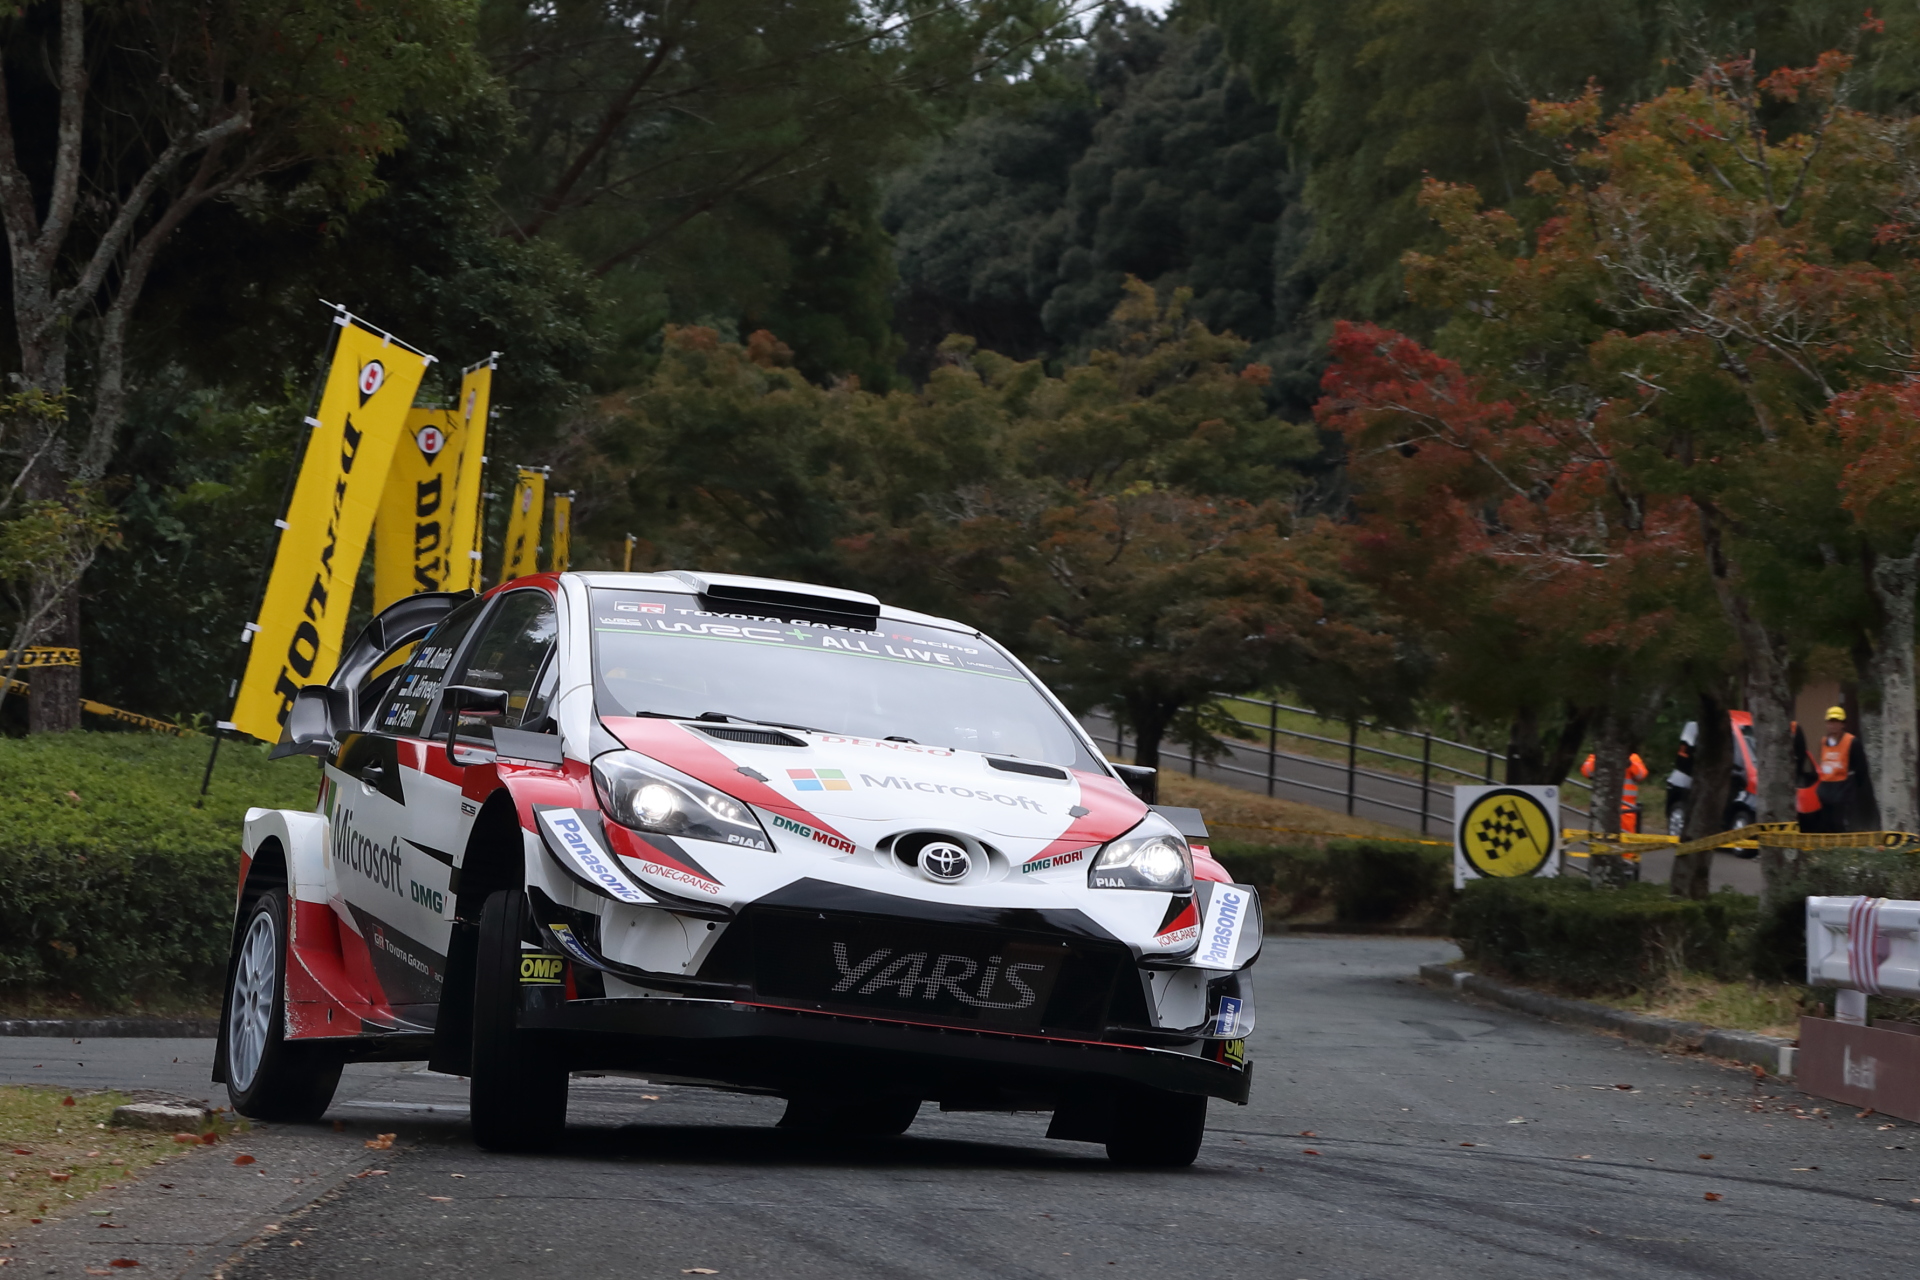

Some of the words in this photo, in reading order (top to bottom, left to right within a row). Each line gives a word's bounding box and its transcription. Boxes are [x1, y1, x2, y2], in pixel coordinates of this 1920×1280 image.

[616, 603, 665, 614] GR
[674, 608, 782, 623] TOYOTA
[789, 618, 885, 638] GAZOO
[891, 634, 978, 655] Racing
[821, 635, 880, 655] ALL
[885, 644, 955, 666] LIVE
[821, 734, 954, 758] DENSO
[859, 773, 1048, 816] Microsoft
[332, 803, 404, 898] Microsoft
[727, 833, 766, 851] PIAA
[772, 815, 811, 838] DMG
[811, 829, 857, 855] MORI
[553, 818, 641, 903] Panasonic
[1022, 857, 1051, 874] DMG
[1052, 850, 1084, 867] MORI
[641, 862, 721, 895] KONECRANES
[1096, 877, 1126, 888] PIAA
[410, 879, 443, 914] DMG
[1201, 892, 1241, 965] Panasonic
[385, 938, 408, 963] TOYOTA
[407, 953, 429, 976] GAZOO
[520, 957, 563, 979] OMP
